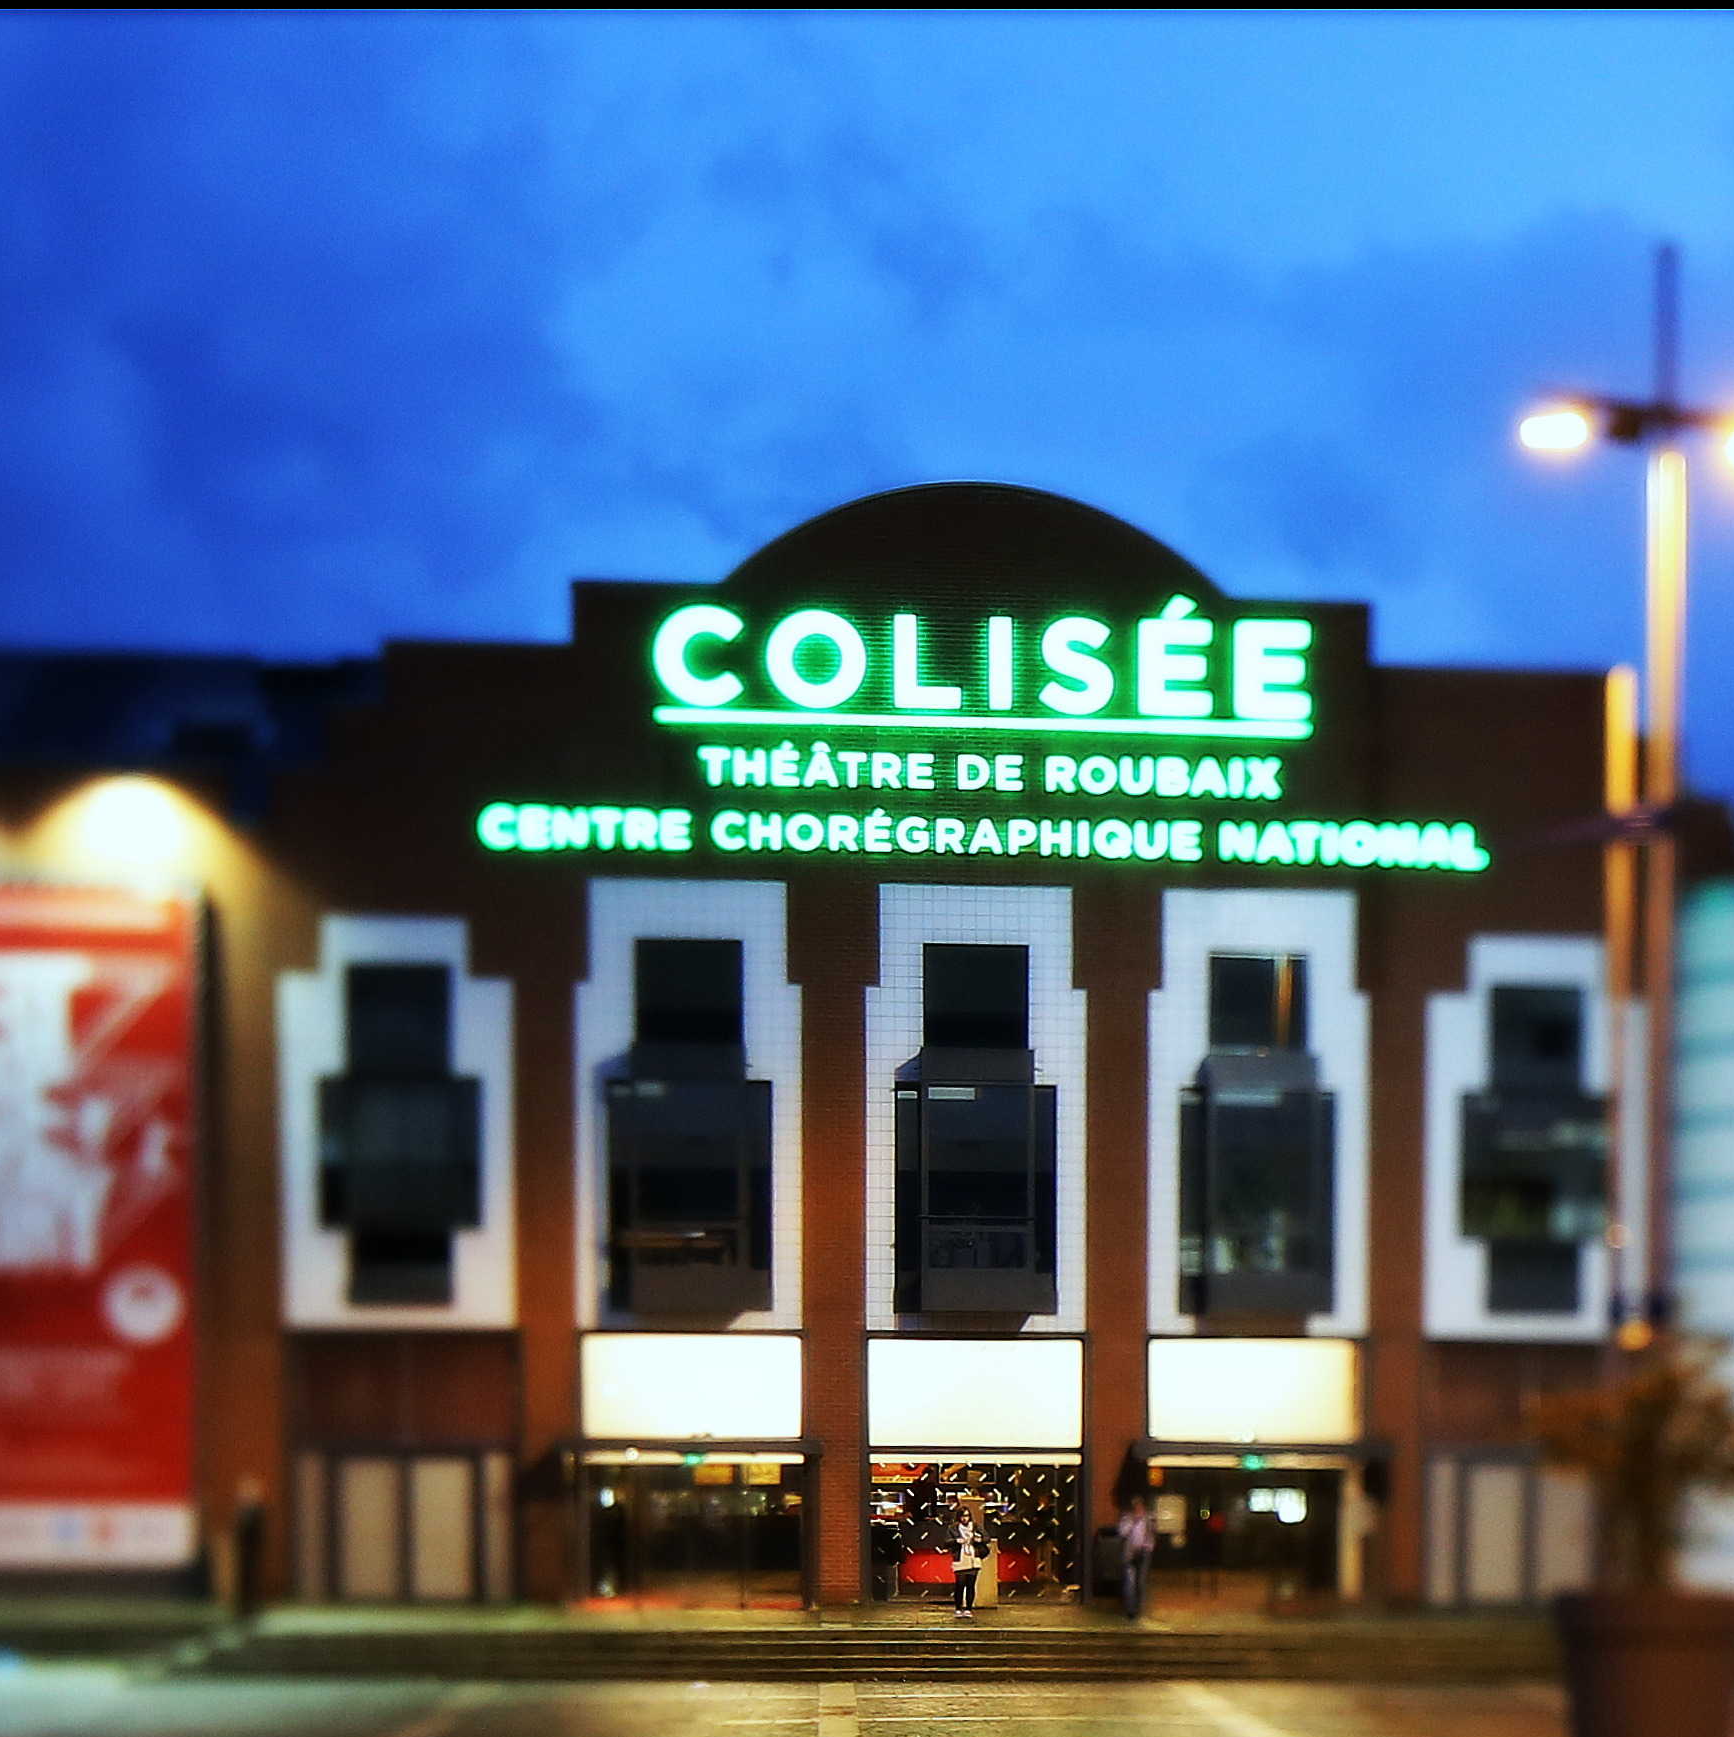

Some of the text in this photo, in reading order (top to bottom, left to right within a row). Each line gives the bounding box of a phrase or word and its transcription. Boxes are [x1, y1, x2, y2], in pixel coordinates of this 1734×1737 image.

[654, 594, 1313, 720] COLISÉE
[699, 742, 1283, 800] THÉÂTRE DE ROUBAIX
[478, 802, 1491, 872] CENTRE CHORÉGRAPHIQUE NATIONAL
